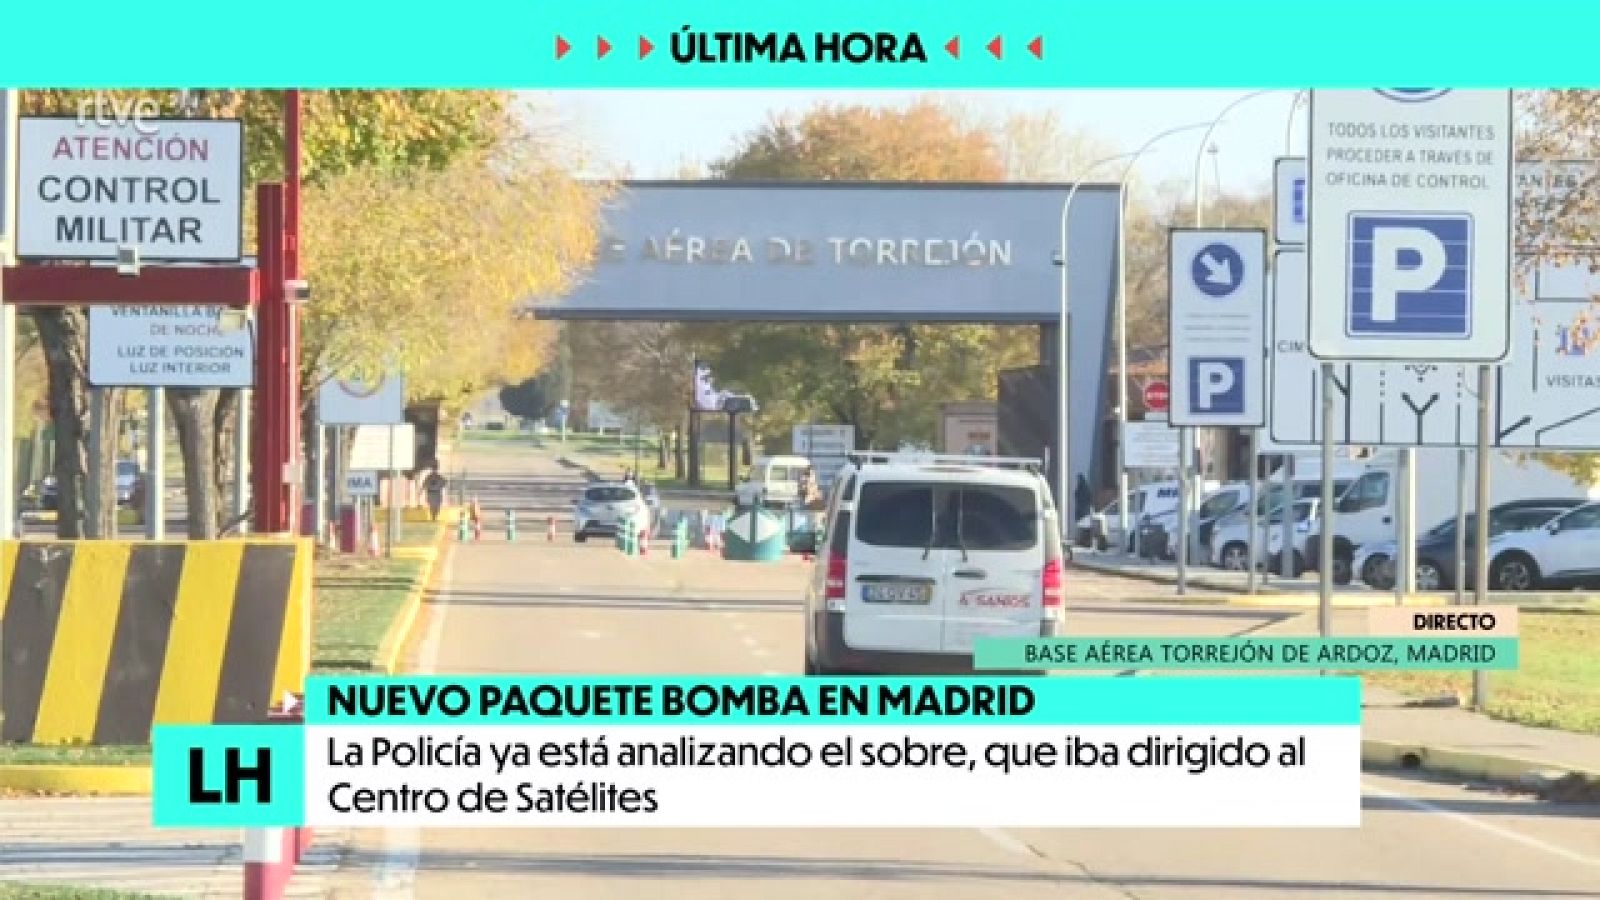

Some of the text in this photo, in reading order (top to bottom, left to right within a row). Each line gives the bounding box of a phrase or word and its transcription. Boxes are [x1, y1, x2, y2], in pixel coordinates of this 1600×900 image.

[1328, 122, 1496, 140] TODOS LOS VISITANTES
[52, 132, 209, 162] ATENCIÓN
[1326, 147, 1402, 163] PROCEDER
[1404, 150, 1416, 163] A
[1476, 151, 1494, 166] DE
[38, 175, 221, 204] CONTROL
[1325, 172, 1490, 190] OFICINA DE CONTROL
[56, 215, 202, 244] MILITAR
[827, 231, 1012, 266] TORREJÓN
[1371, 226, 1448, 322] P
[150, 324, 227, 336] DE NOCH
[117, 345, 146, 358] LUZ
[149, 345, 168, 358] DE
[129, 362, 231, 373] LUZ INTERIOR
[1198, 362, 1235, 409] P
